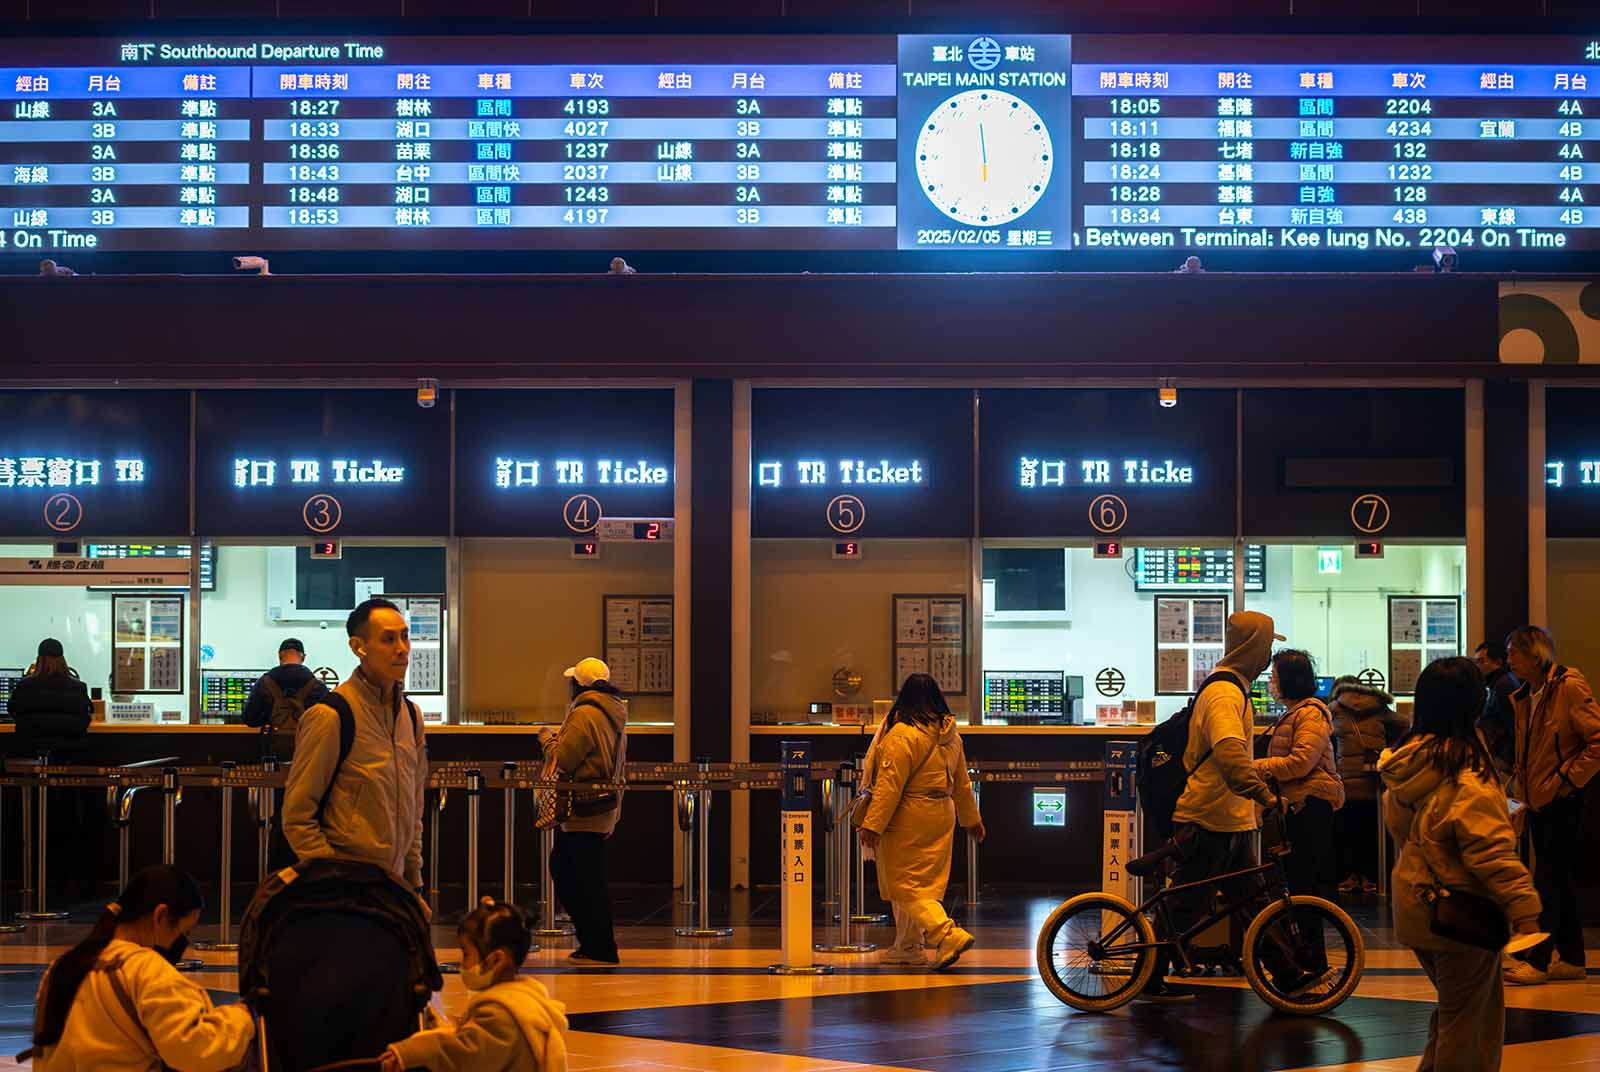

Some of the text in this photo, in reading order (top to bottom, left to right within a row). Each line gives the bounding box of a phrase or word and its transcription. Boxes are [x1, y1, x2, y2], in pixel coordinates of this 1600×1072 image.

[121, 44, 383, 60] 南下 Southbound Departure Time
[933, 46, 1035, 62] 臺北 車站
[16, 74, 216, 92] 經由 月台 備註
[280, 73, 862, 91] 開車時刻 開往 車種 車次 經由 月台 備註
[904, 72, 1066, 86] TAIPEI MAIN STATION
[1100, 72, 1587, 90] 開車時刻 開往 車種 車次 經由 月台
[15, 100, 216, 119] 山線 3A 準點
[290, 98, 862, 117] 18:27 樹林 區間 4193 3A 準點
[1110, 99, 1583, 116] 18:05 基隆 區間 2204 4A
[92, 122, 216, 138] 3B 準點
[289, 120, 862, 138] 18:33 湖口 區間快 4027 3B 準點
[1110, 121, 1583, 138] 18:11 福隆 區間 4234 宜蘭 4B
[92, 144, 215, 160] 3A 準點
[289, 142, 862, 160] 18:36 苗栗 區間 1237 山線 3A 準點
[1110, 143, 1583, 159] 18:18 七堵 新自強 132 4A
[14, 166, 215, 183] 海線 3B 準點
[289, 164, 862, 182] 18:43 台中 區間快 2037 山線 3B 準點
[1110, 165, 1583, 181] 18:24 基隆 區間 1232 4B
[91, 188, 215, 204] 3A 準點
[288, 186, 862, 203] 18:48 湖口 區間 1243 3A 準點
[1110, 187, 1583, 202] 18:28 基隆 自強 128 4A
[14, 210, 214, 228] 山線 3B 準點
[288, 208, 862, 226] 18:53 樹林 區間 4197 3B 準點
[1110, 208, 1583, 225] 18:34 台東 新自強 438 東線 4B
[14, 232, 42, 247] On
[48, 231, 96, 247] Time
[917, 230, 1052, 245] 2025/02/05 星期三
[1087, 229, 1174, 246] Between
[1182, 229, 1273, 247] Terminal:
[1282, 230, 1320, 246] Kee
[1376, 230, 1411, 246] No.
[1420, 230, 1473, 246] 2204
[1481, 230, 1510, 246] On
[1516, 230, 1566, 247] Time
[291, 460, 320, 483] TR
[556, 461, 583, 484] TR
[598, 461, 668, 484] Ticke
[798, 462, 825, 483] TR
[840, 461, 921, 483] Ticket
[1083, 461, 1110, 483] TR
[1124, 461, 1192, 483] Ticke
[648, 524, 658, 538] 2
[325, 544, 332, 554] 3
[586, 544, 593, 553] 4
[847, 544, 853, 554] 5
[1108, 544, 1115, 554] 6
[1371, 544, 1377, 554] 7
